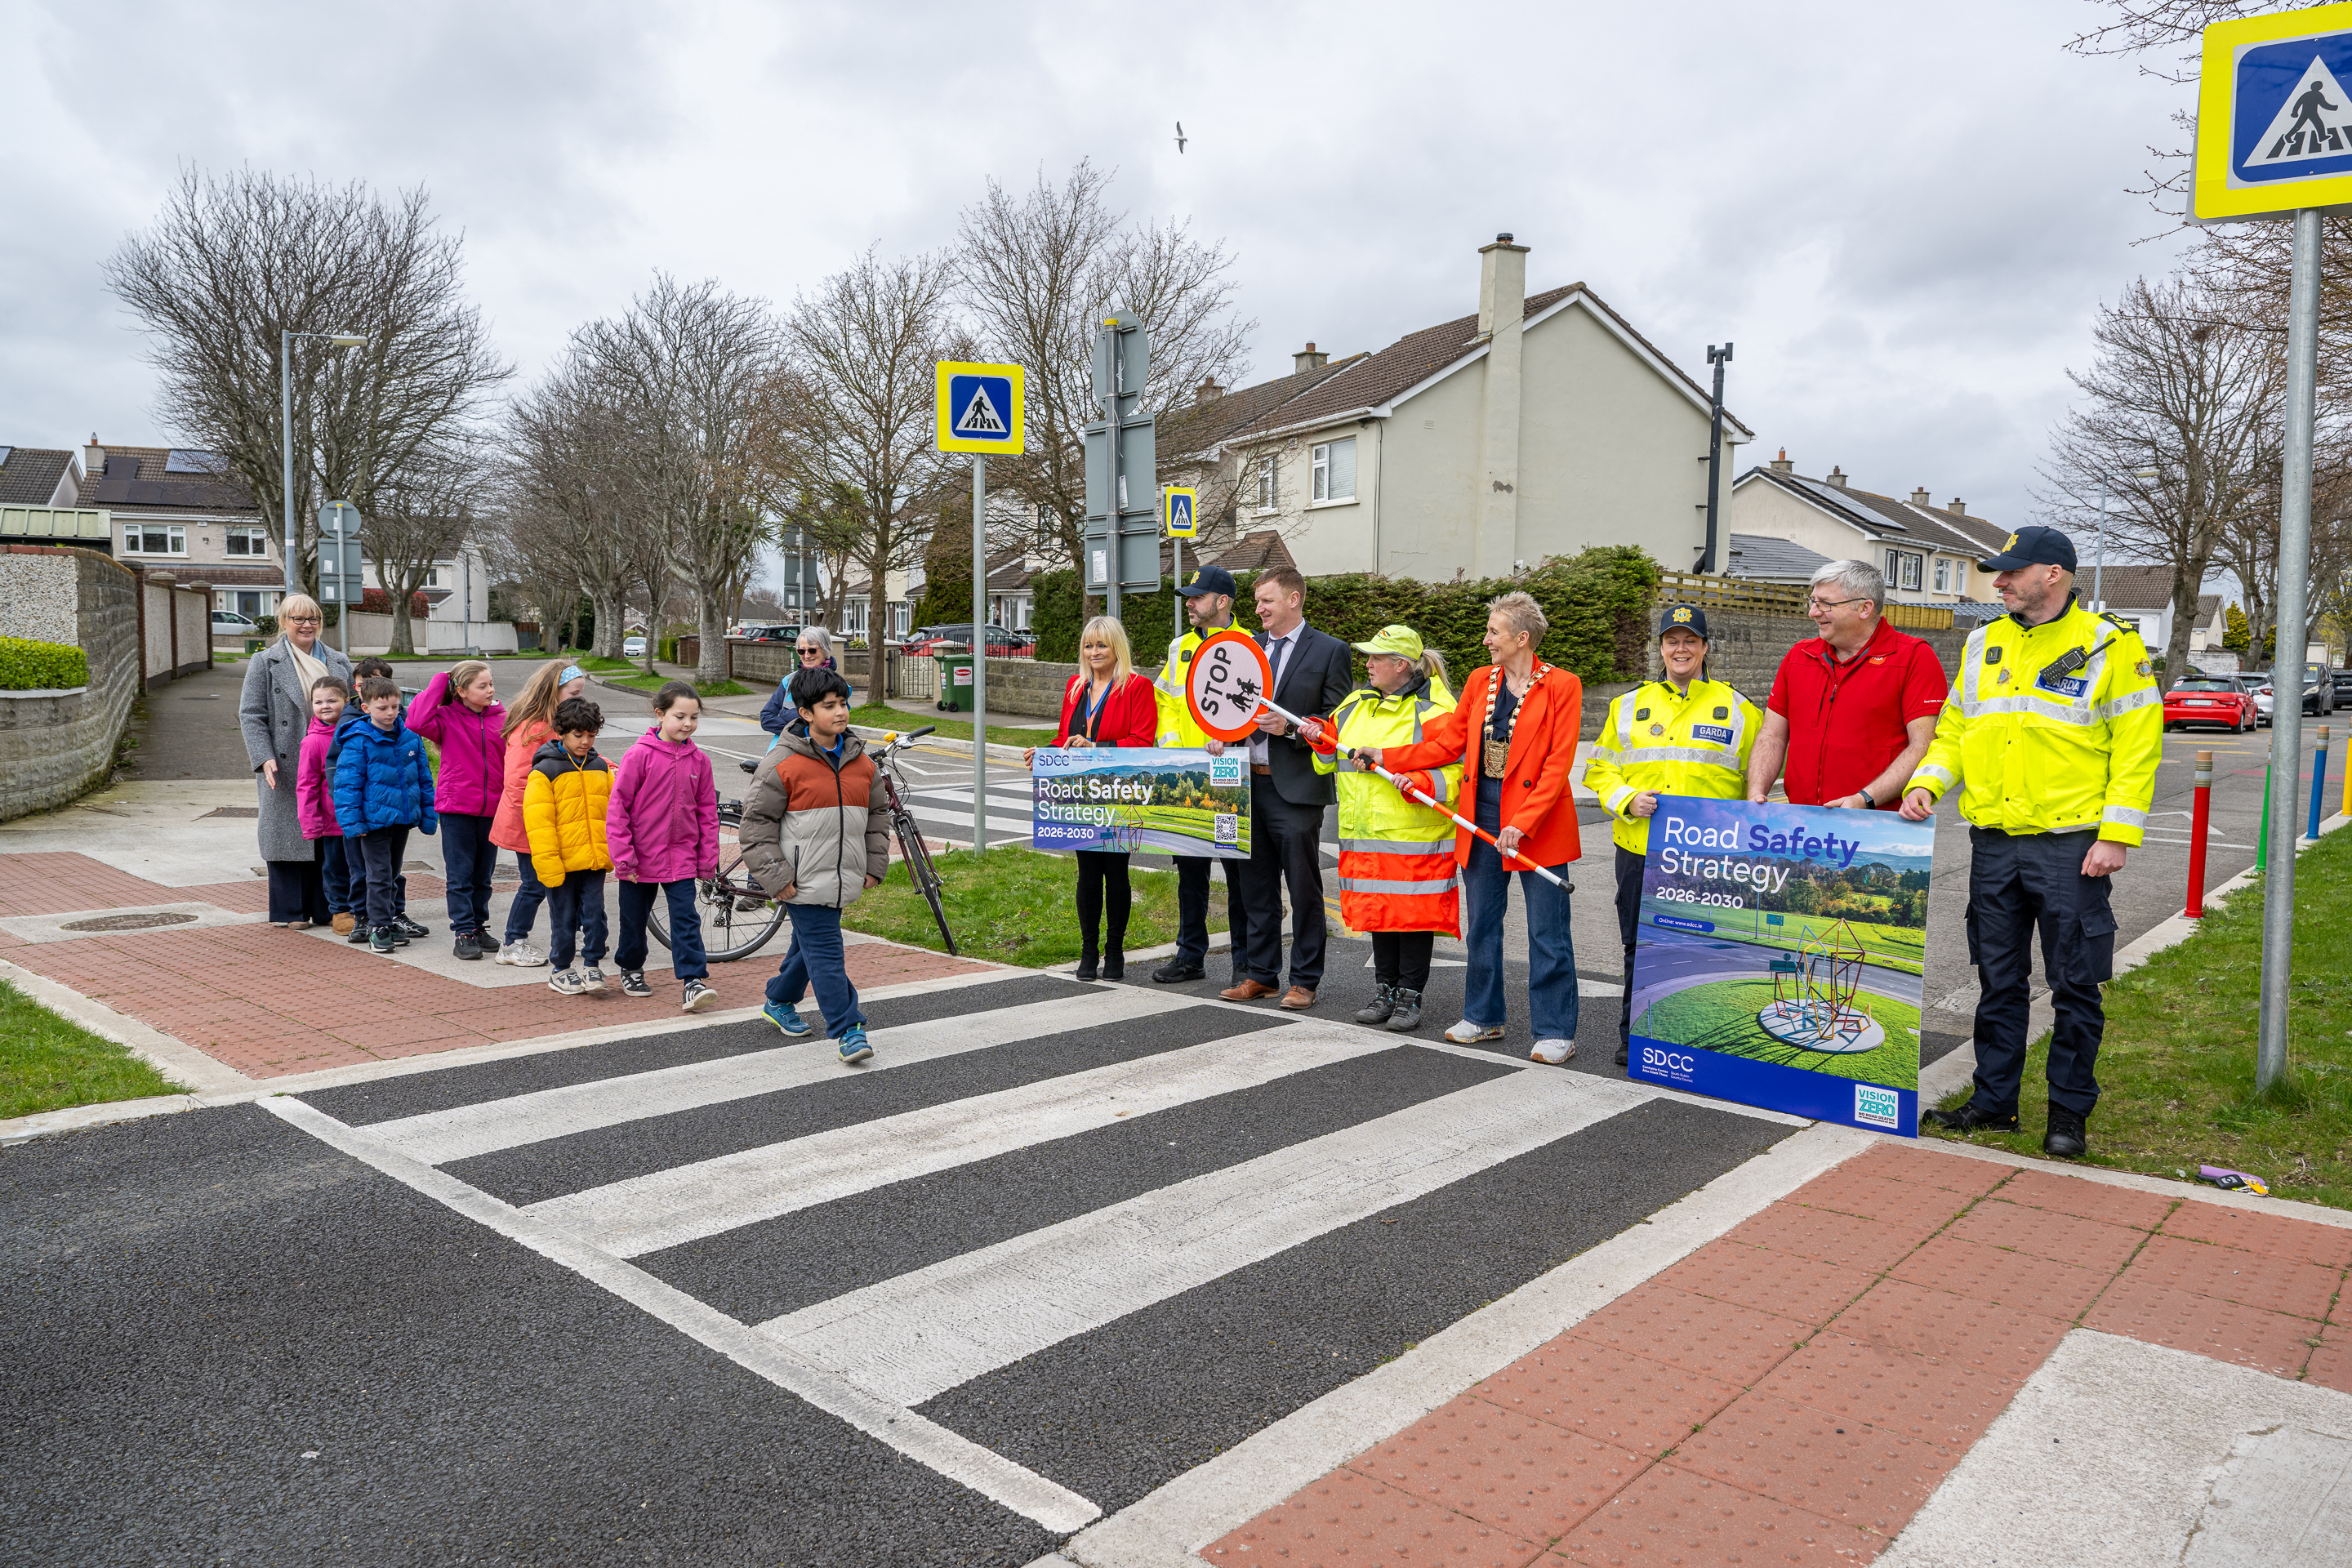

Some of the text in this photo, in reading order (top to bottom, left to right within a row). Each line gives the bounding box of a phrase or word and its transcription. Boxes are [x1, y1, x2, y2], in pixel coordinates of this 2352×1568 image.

[1201, 647, 1232, 716] STOP
[2047, 678, 2080, 692] ARDA
[1699, 726, 1727, 739] GARDA
[1039, 755, 1070, 767] SDCC
[1212, 757, 1238, 765] VISION
[1213, 766, 1239, 778] ZERO
[1038, 777, 1153, 806] Road Safety
[1038, 800, 1116, 827] Strategy
[1037, 826, 1094, 839] 2026-2030
[1664, 816, 1860, 868] Road Safety
[1660, 847, 1791, 893] Strategy
[1655, 886, 1744, 910] 2026-2030
[1674, 920, 1703, 929] www.sdcc.ie
[1642, 1047, 1694, 1072] SDCC
[1858, 1089, 1895, 1104] VISION
[1859, 1098, 1895, 1117] ZERO
